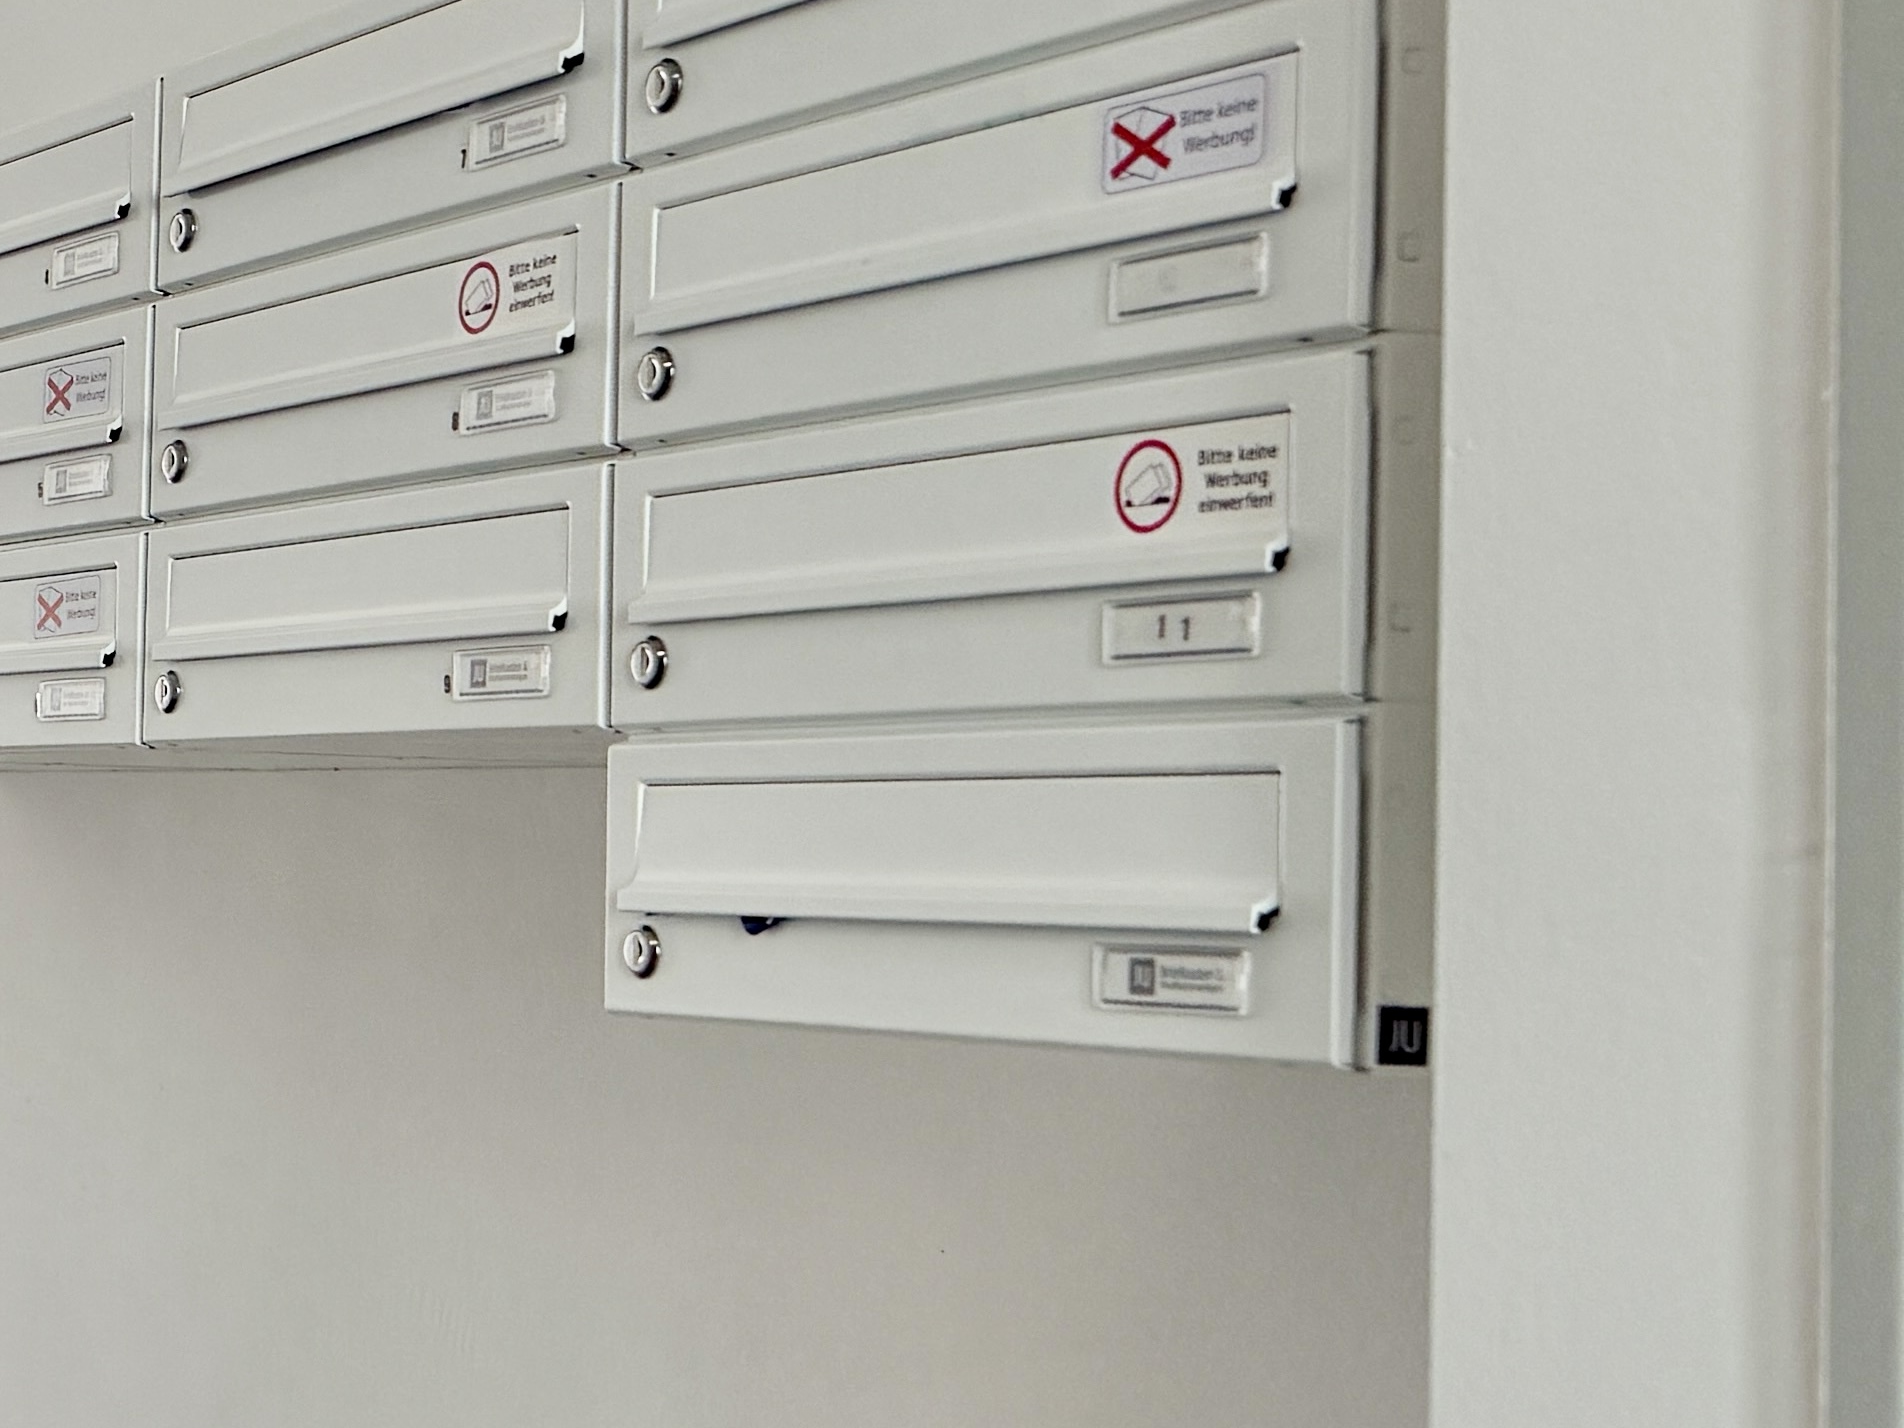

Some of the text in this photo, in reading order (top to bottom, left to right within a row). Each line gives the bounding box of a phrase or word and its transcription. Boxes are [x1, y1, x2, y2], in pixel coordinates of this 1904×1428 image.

[1180, 98, 1258, 127] Bitte keine
[1183, 123, 1257, 154] Werbung!
[509, 254, 557, 277] Bitte keine
[513, 274, 552, 292] Werbung
[508, 289, 554, 313] einwerfen!
[1197, 444, 1278, 466] Bitte keine
[1204, 469, 1269, 488] Werbung
[1198, 491, 1275, 513] einwerfen!
